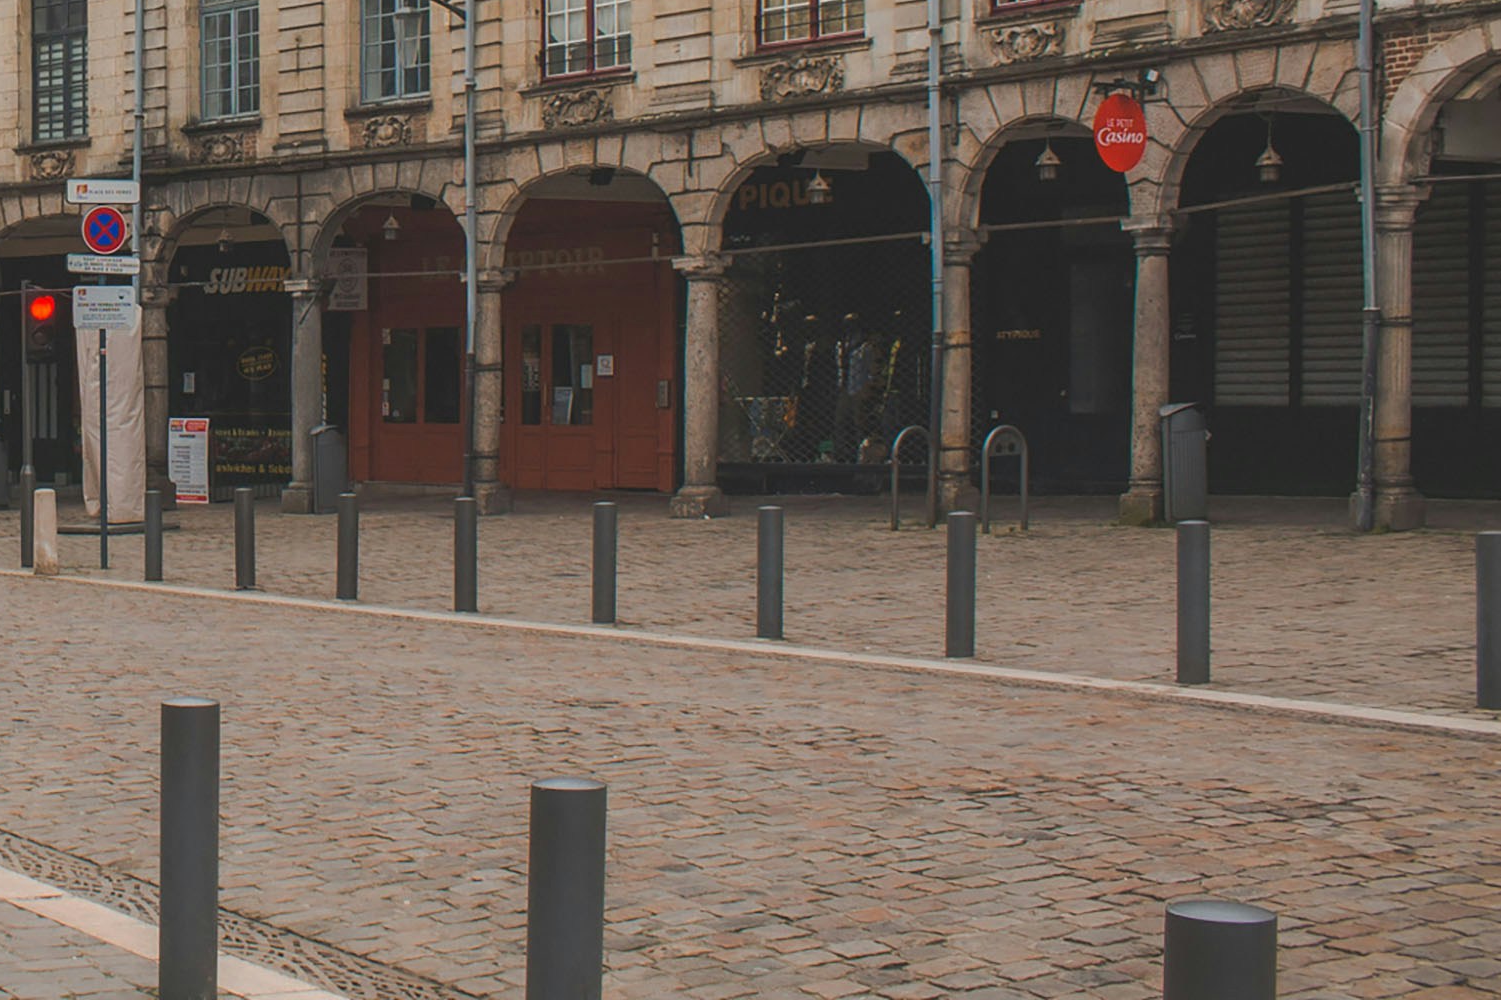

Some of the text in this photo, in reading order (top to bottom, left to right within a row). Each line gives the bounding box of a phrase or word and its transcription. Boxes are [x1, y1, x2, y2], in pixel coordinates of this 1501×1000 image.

[1097, 127, 1144, 147] Casino
[739, 177, 835, 210] PIQUE
[204, 265, 291, 294] SUBWAY
